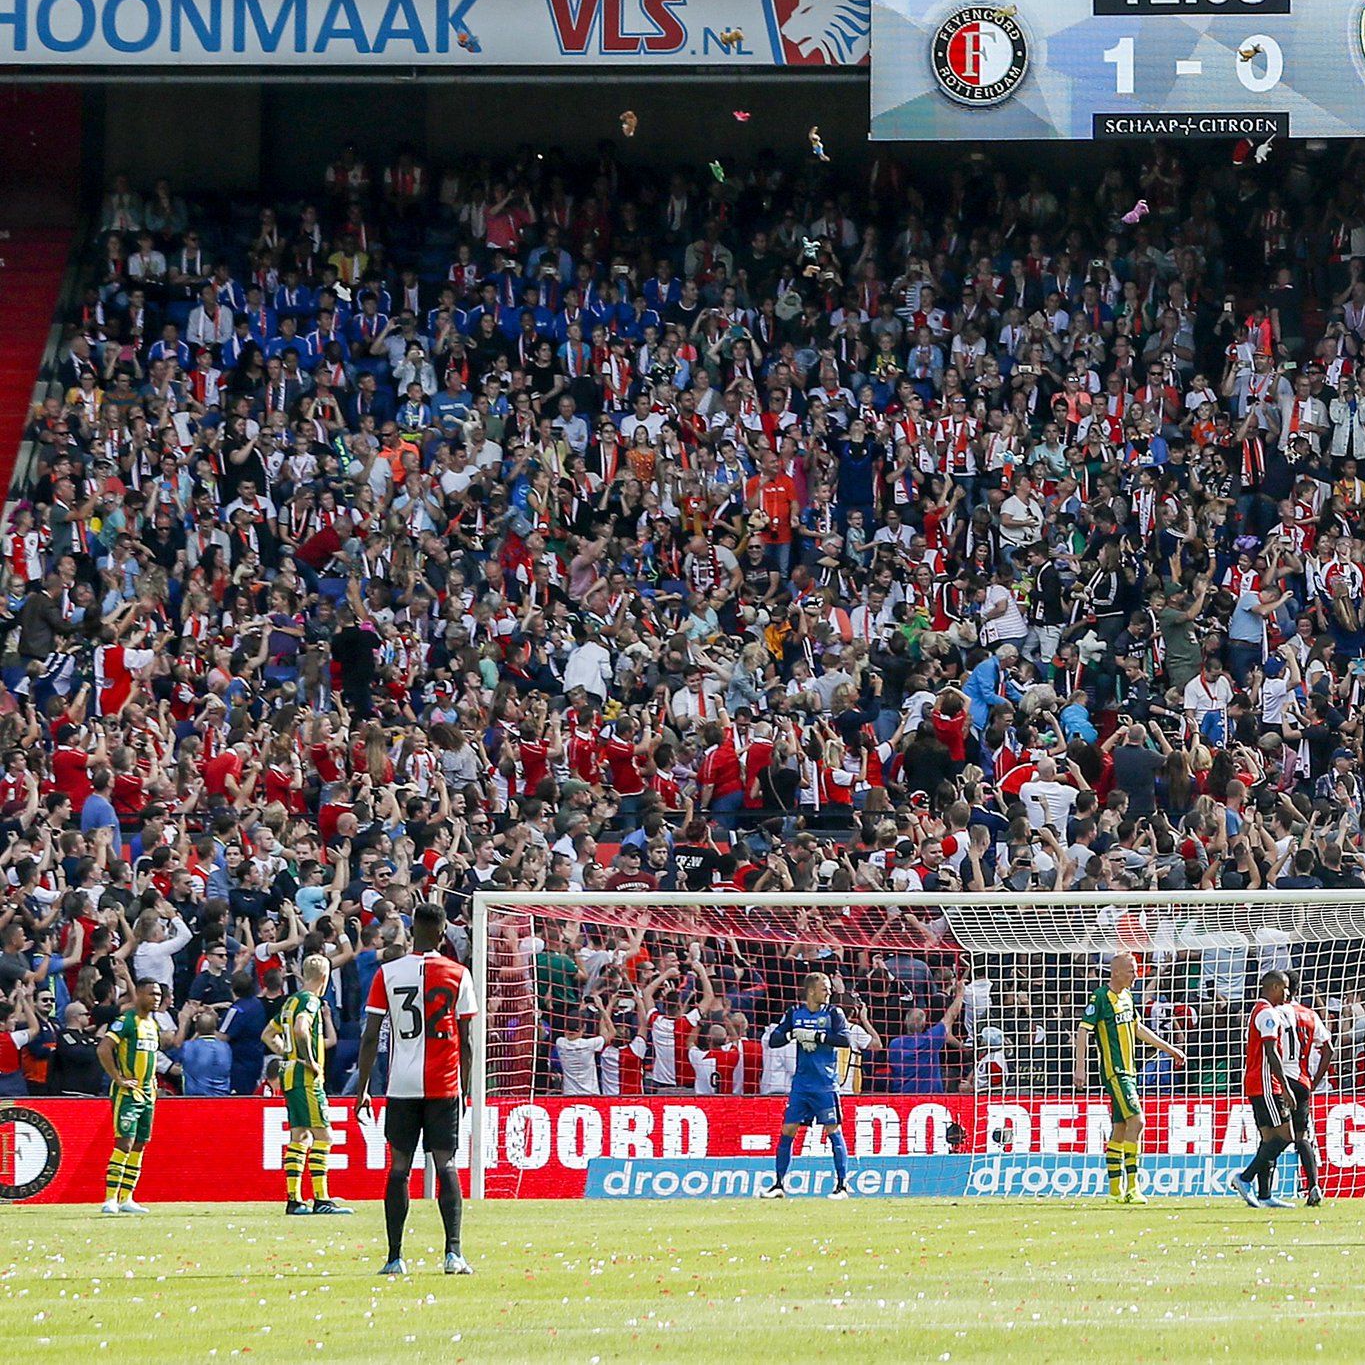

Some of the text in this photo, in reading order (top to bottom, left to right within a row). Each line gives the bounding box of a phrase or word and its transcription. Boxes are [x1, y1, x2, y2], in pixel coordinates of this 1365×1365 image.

[1103, 37, 1136, 94] 1
[1236, 34, 1283, 93] 0
[1105, 118, 1182, 134] SCHAAP
[392, 986, 451, 1040] 32
